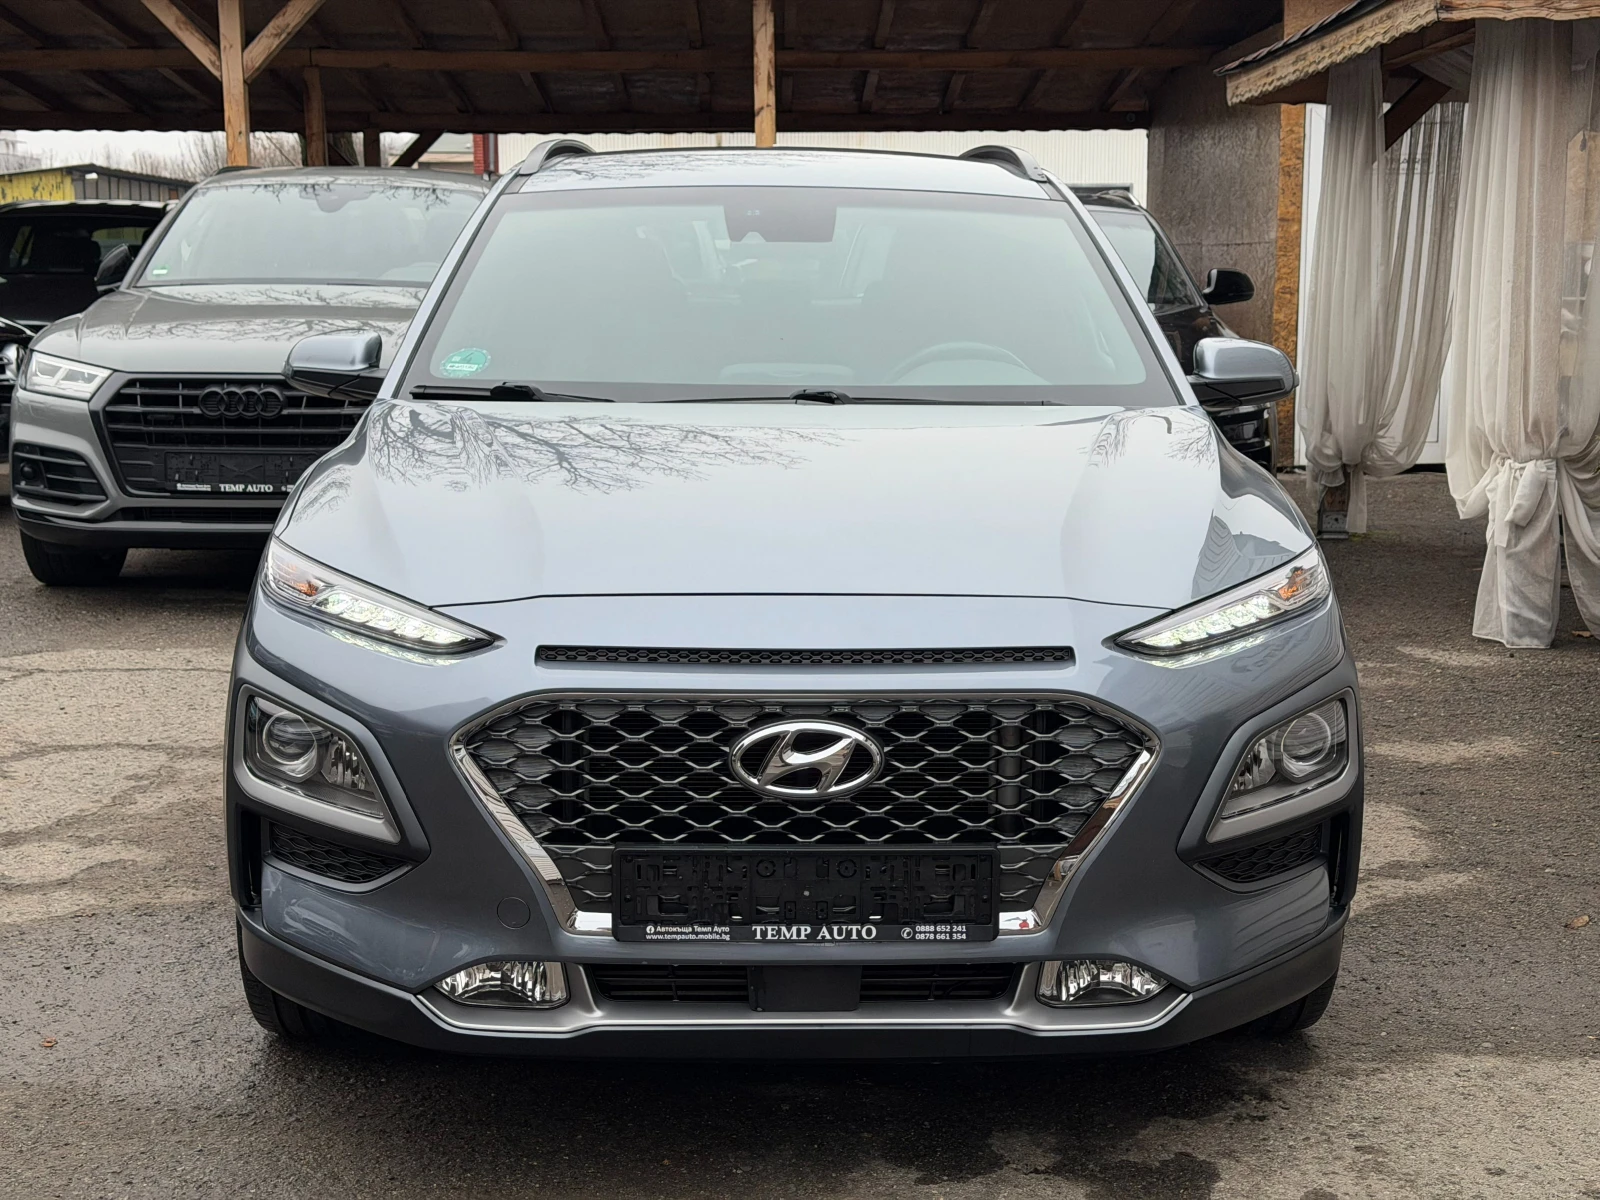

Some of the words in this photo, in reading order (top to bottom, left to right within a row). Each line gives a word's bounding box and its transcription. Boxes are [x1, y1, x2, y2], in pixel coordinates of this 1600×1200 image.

[219, 483, 245, 492] TEMP
[246, 484, 274, 492] AUTO
[656, 925, 692, 933] Автокъща
[713, 925, 730, 933] Ауто
[751, 925, 812, 940] TEMP
[816, 925, 877, 940] AUTO
[645, 933, 731, 941] www.tempauto.mobile.bg
